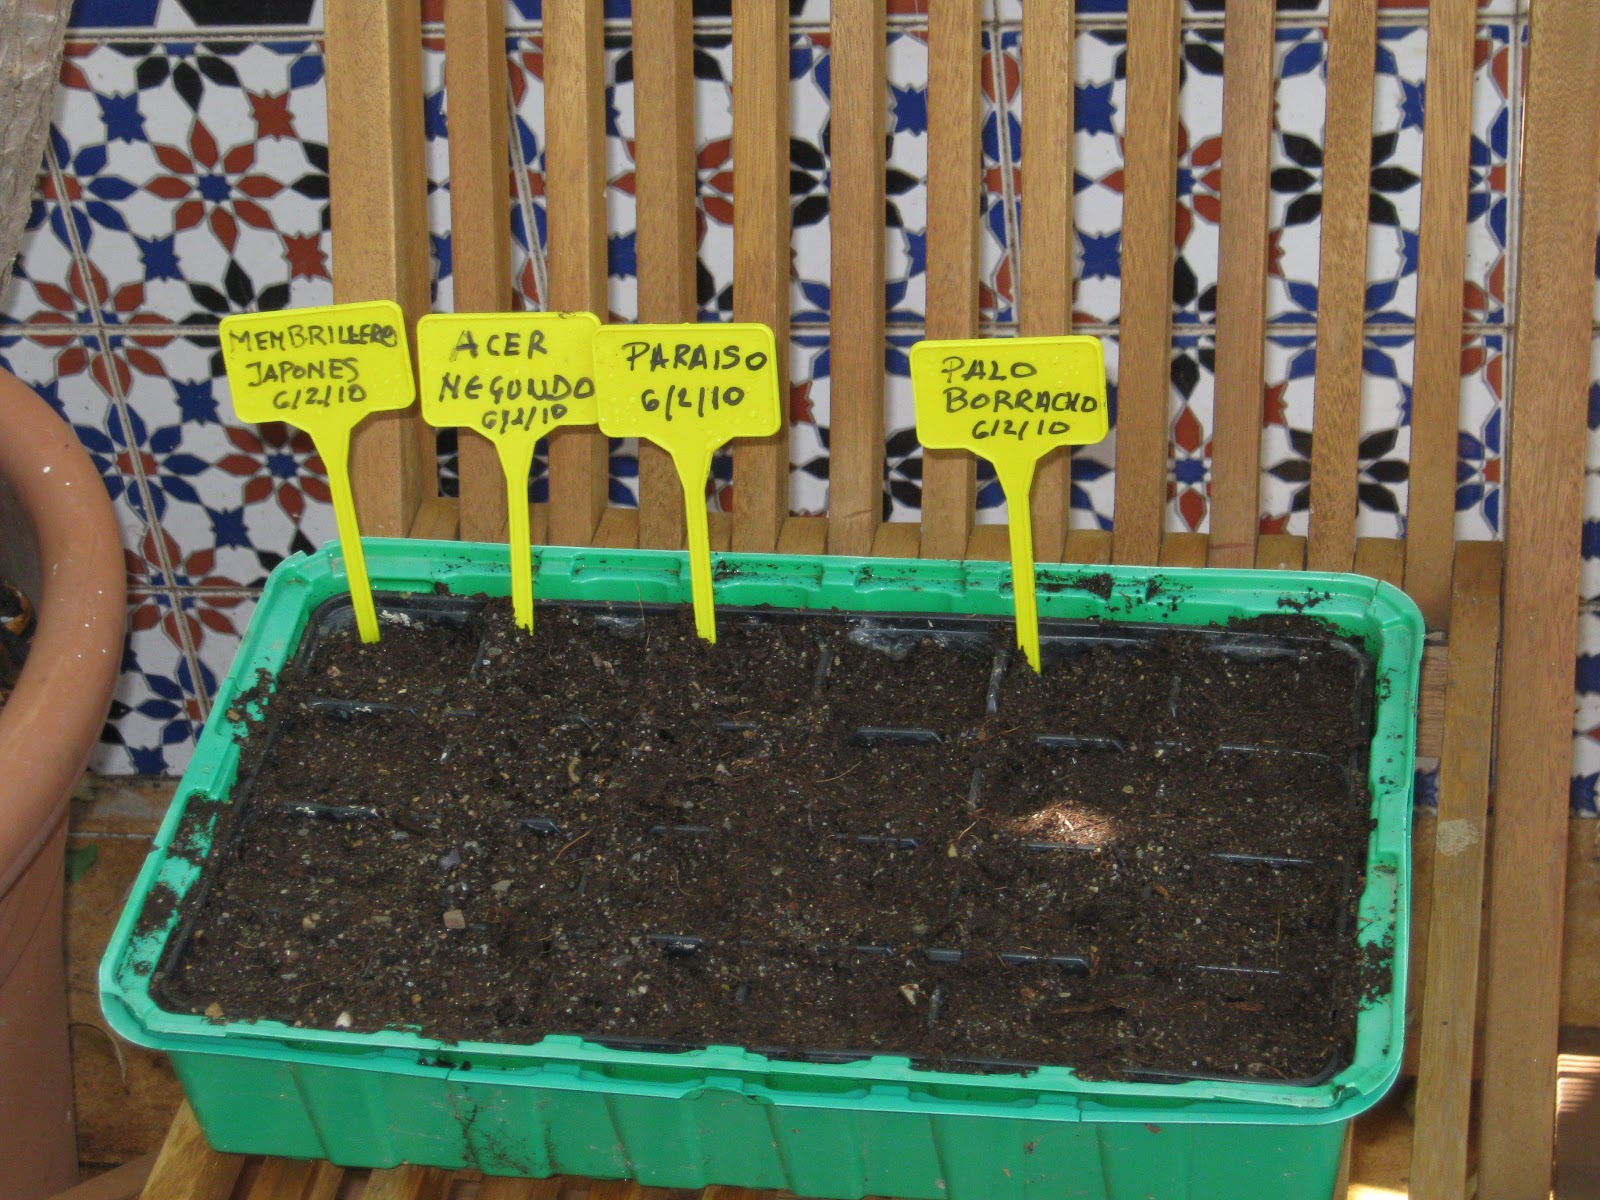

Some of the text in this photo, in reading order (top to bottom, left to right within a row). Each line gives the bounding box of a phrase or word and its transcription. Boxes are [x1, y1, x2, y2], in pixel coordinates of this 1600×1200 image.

[449, 330, 548, 362] ACER
[621, 341, 768, 372] PARAISO
[245, 357, 360, 387] JAPONES
[941, 356, 1038, 383] PALO
[272, 383, 367, 410] 6/2/10
[641, 384, 745, 422] 6/2/10
[942, 386, 1098, 414] BORRACHO
[971, 419, 1071, 441] 6/2/10
